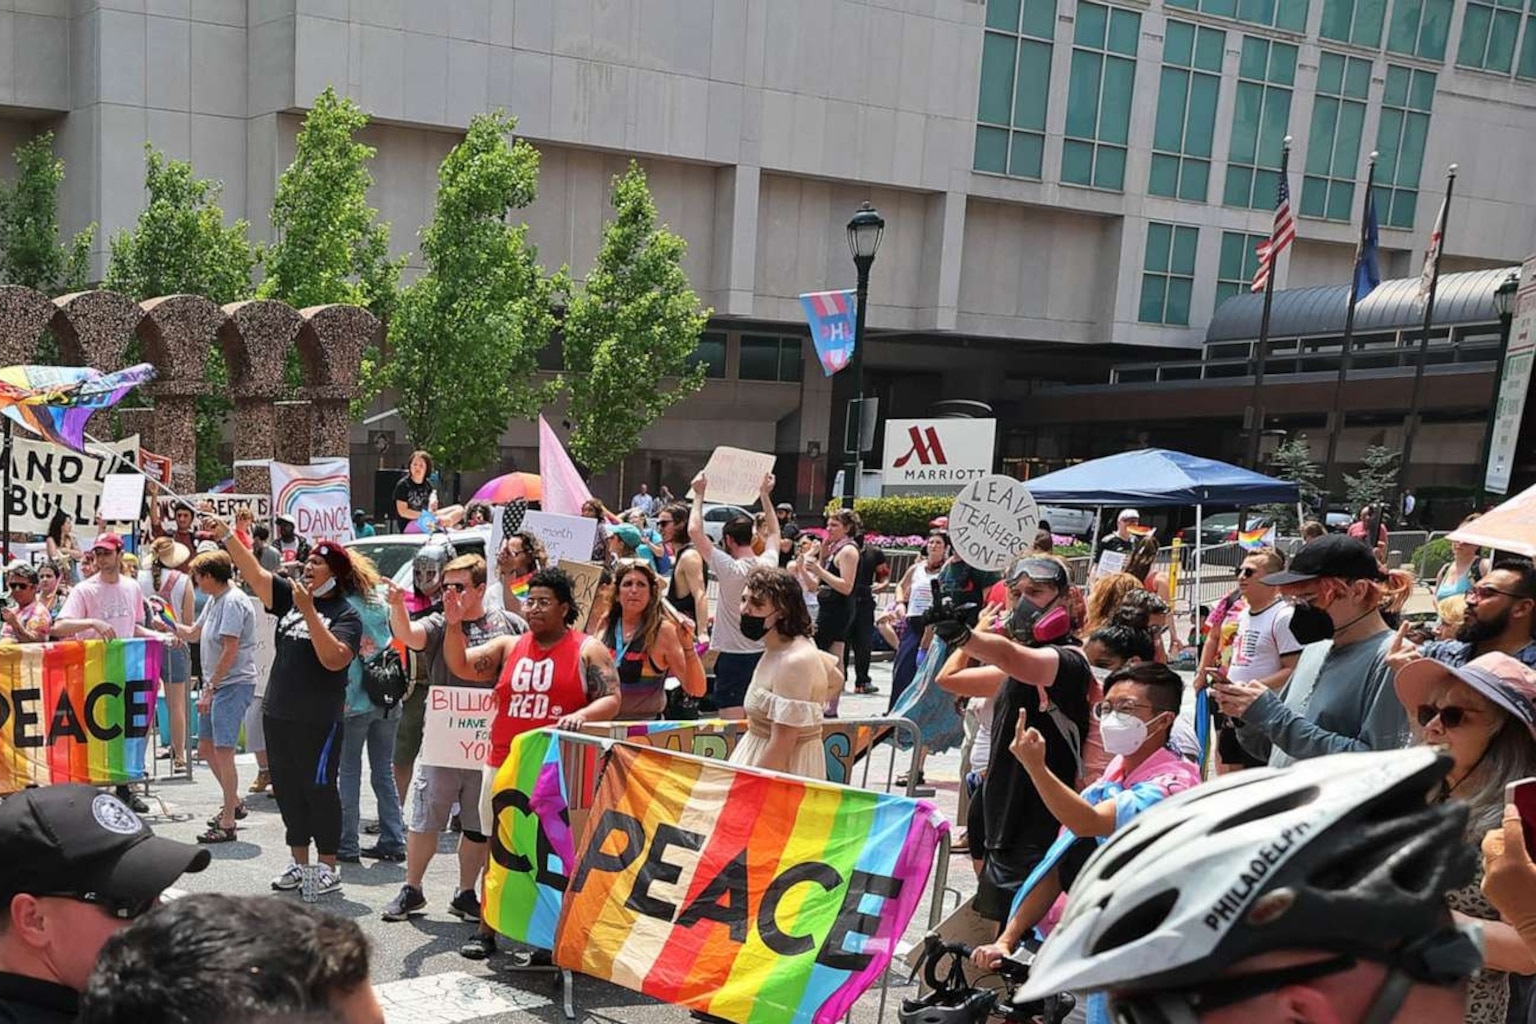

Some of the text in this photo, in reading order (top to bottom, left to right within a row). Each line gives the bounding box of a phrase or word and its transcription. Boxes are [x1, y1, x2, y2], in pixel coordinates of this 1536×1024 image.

[905, 469, 986, 480] MARRIOTT
[258, 498, 269, 516] IS
[971, 480, 1035, 532] LEAVE
[298, 507, 349, 533] DANCE
[959, 501, 1028, 557] TEACHERS
[511, 656, 554, 692] GO
[507, 693, 550, 719] RED
[448, 717, 486, 728] I HAVE
[569, 809, 904, 972] PEACE
